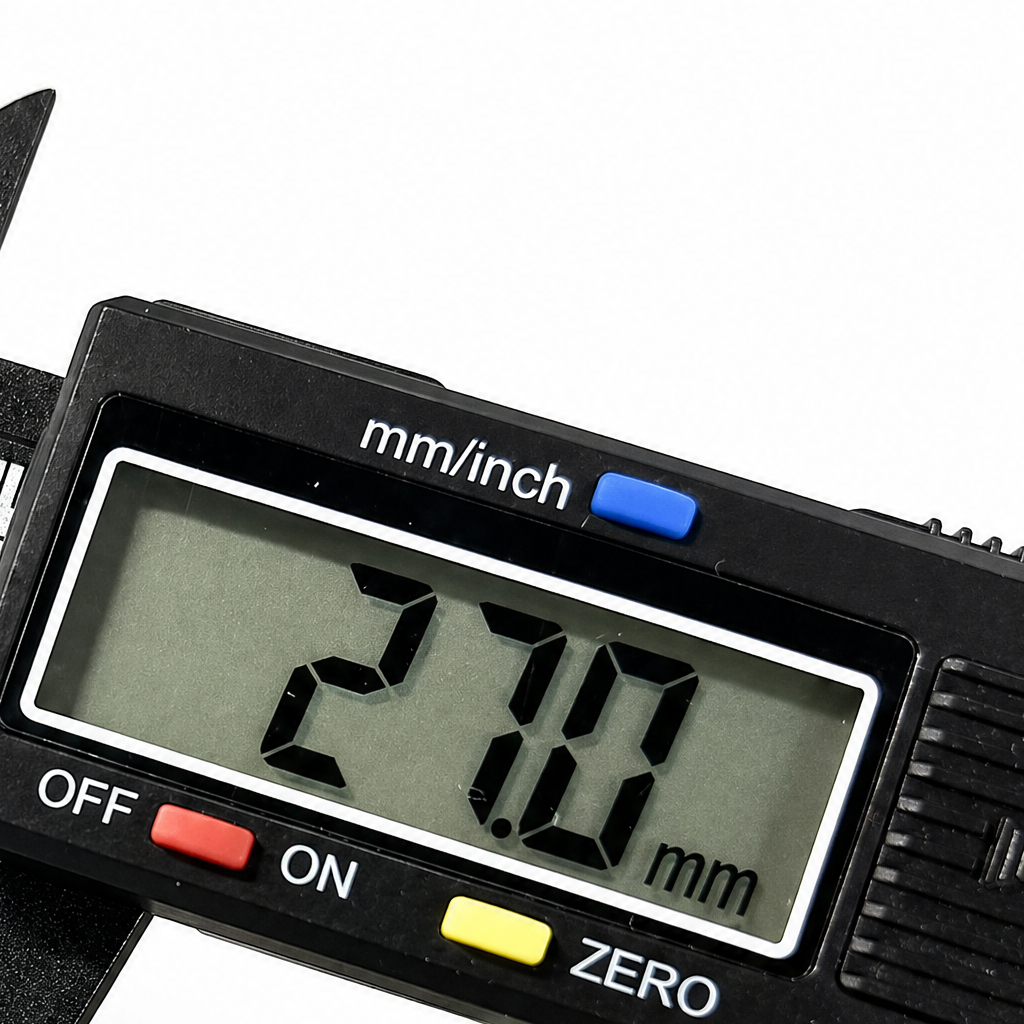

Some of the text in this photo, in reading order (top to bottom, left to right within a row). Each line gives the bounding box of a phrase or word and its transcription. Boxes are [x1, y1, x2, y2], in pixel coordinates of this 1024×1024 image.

[358, 418, 572, 511] mm/inch
[260, 562, 760, 918] 27.0 mm
[37, 767, 140, 826] OFF
[279, 843, 359, 900] ON
[568, 936, 719, 1018] ZERO
